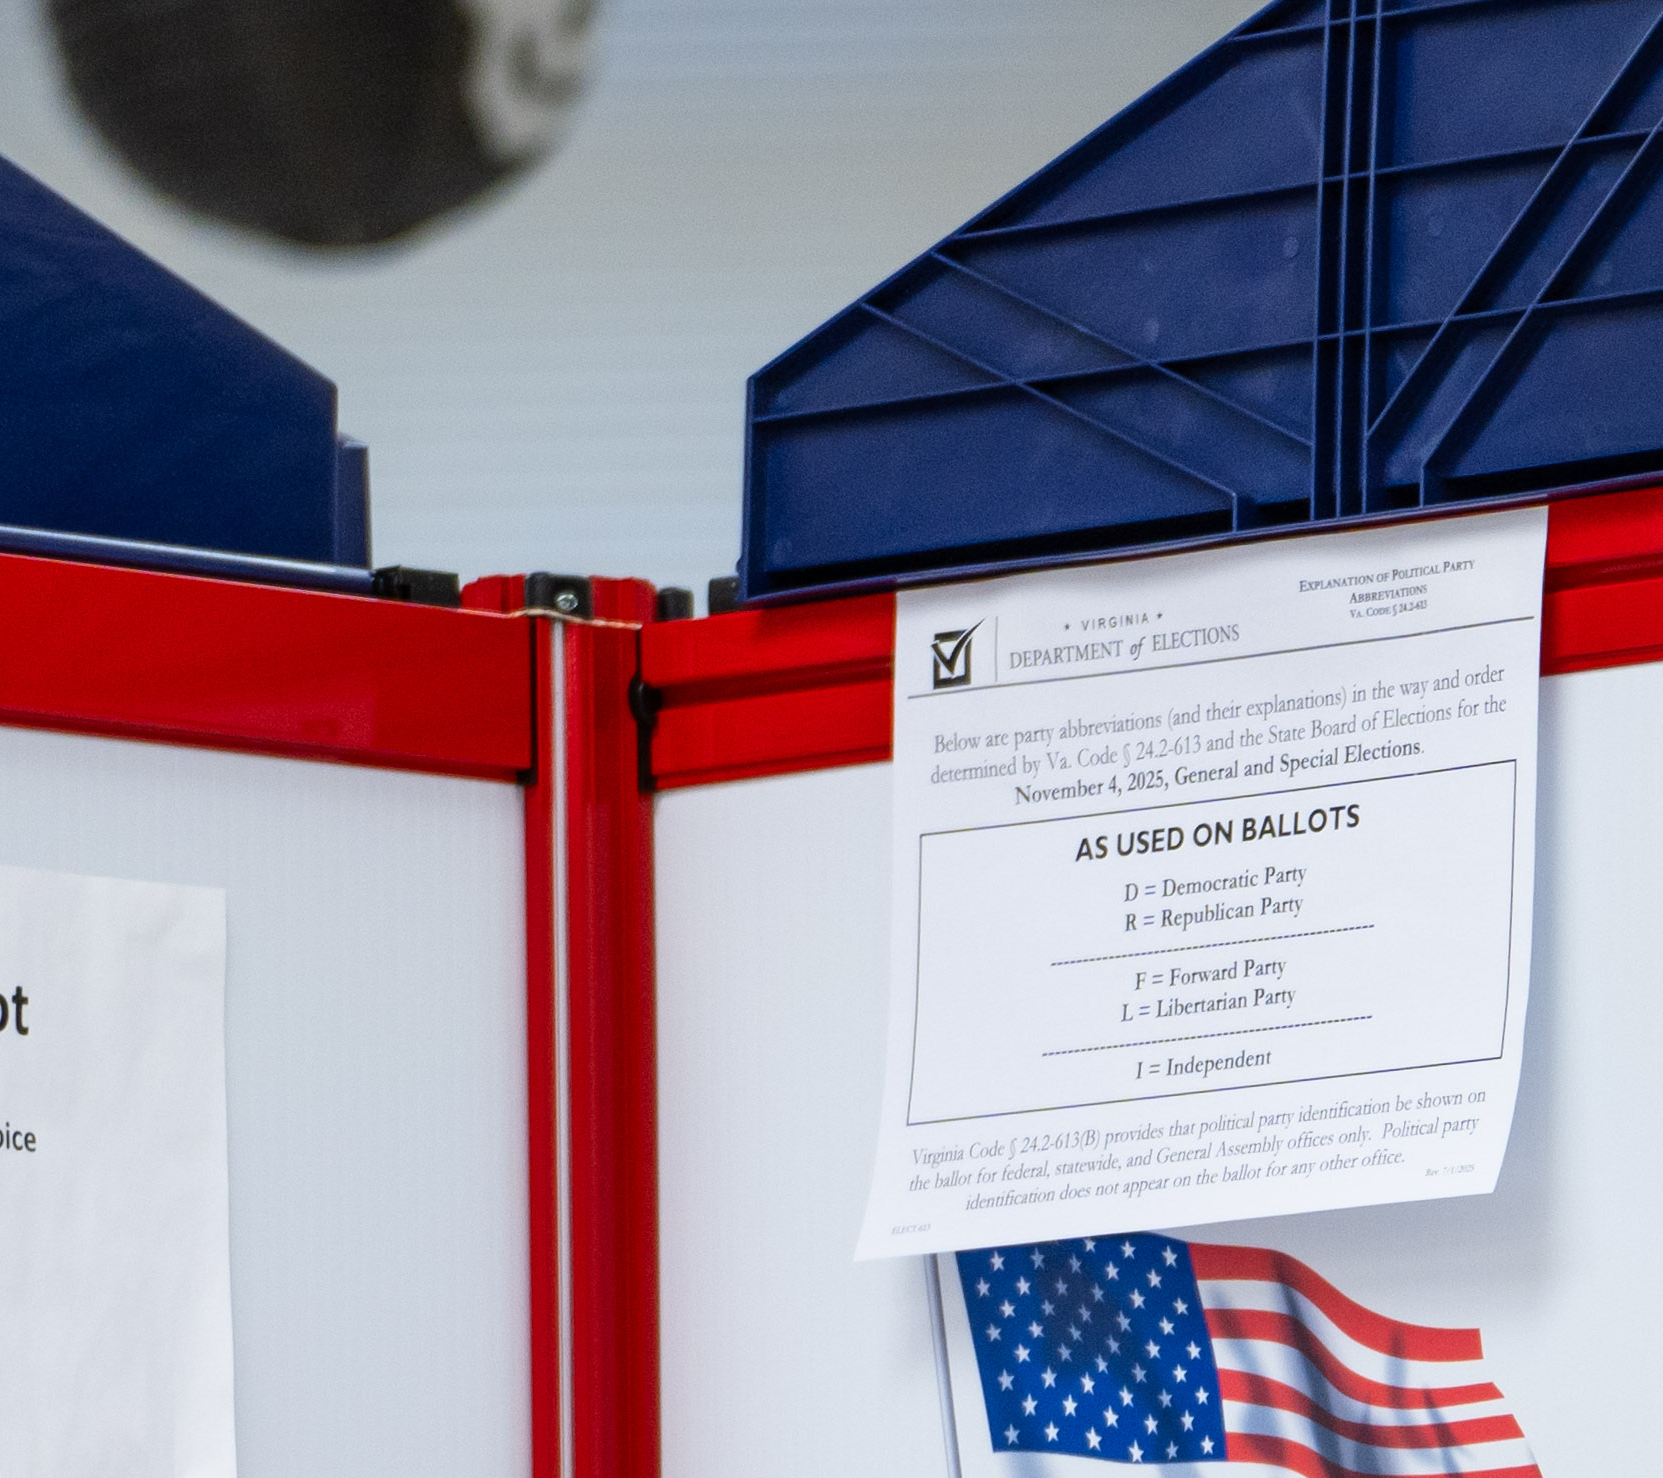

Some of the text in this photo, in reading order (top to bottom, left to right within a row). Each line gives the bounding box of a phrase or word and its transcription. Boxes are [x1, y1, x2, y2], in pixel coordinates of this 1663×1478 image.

[1298, 559, 1476, 593] EXPLANATION OF POLITICAL PARTY
[1349, 584, 1428, 605] ABBREVIATIONS
[1080, 612, 1150, 632] VIRGINIA
[1009, 623, 1240, 670] DEPARTMENT of ELECTIONS
[933, 663, 1506, 754] Below are party abbreviations (and their explanations) in the way and order
[930, 755, 1017, 785] determined
[1021, 754, 1042, 780] by
[1045, 751, 1073, 770] Va.
[1076, 744, 1119, 768] Code
[1135, 734, 1202, 761] 24.2-613
[1206, 729, 1235, 752] and
[1239, 727, 1264, 748] the
[1267, 724, 1306, 745] State
[1310, 713, 1357, 739] Board
[1360, 710, 1381, 732] of
[1382, 704, 1453, 729] Elections
[1457, 698, 1480, 719] for
[1483, 693, 1507, 715] the
[1014, 739, 1426, 806] November 4, 2025, General and Special Elections.
[1075, 803, 1360, 862] AS USED ON BALLOTS
[1124, 866, 1307, 903] D = Democratic Party
[1125, 896, 1304, 932] R = Republican Party
[1134, 958, 1287, 991] F = Forward Party
[1120, 987, 1294, 1023] L = Libertarian Party
[1135, 1049, 1272, 1080] I = Independent
[912, 1144, 966, 1170] Virginia
[969, 1139, 1006, 1159] Code
[1019, 1128, 1101, 1154] 24.2-613(B)
[1103, 1122, 1165, 1151] provides
[1167, 1119, 1196, 1139] that
[1197, 1110, 1256, 1140] political
[1256, 1112, 1295, 1134] party
[1297, 1097, 1391, 1123] identification
[1395, 1094, 1413, 1112] be
[1416, 1090, 1463, 1110] shown
[1467, 1090, 1486, 1104] on
[909, 1116, 1481, 1192] the ballot for federal, statewide, and General Assembly offices only. Political party
[965, 1148, 1405, 1211] identification does not appear on the ballot for any other office.
